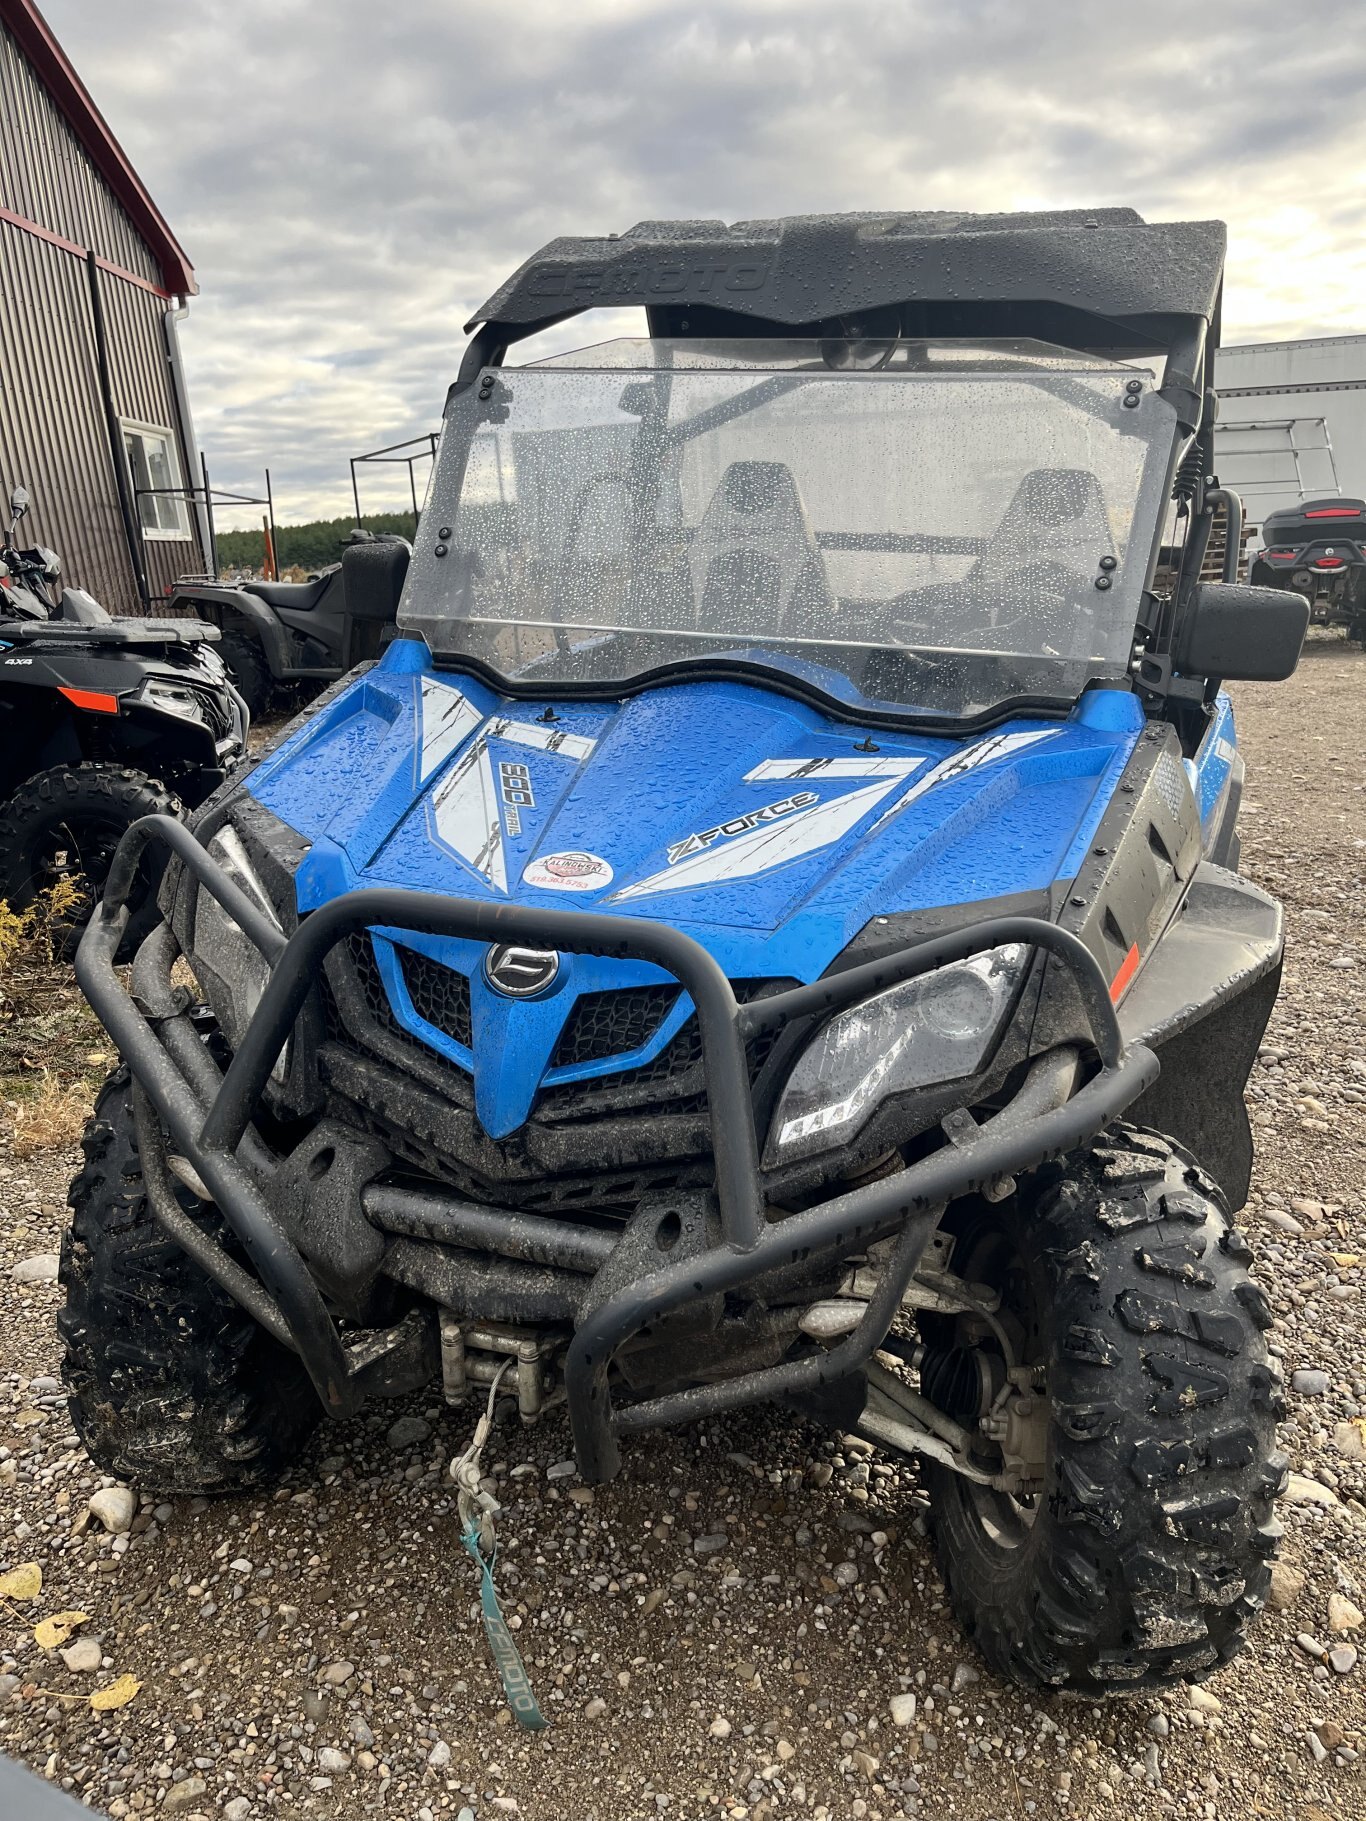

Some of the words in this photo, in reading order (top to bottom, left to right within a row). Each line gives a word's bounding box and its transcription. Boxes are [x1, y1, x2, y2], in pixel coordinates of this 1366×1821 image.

[527, 263, 769, 297] CFMOTO
[499, 762, 533, 807] 800
[504, 805, 521, 837] TRAIL
[543, 859, 604, 874] KALINOWSKI
[486, 1616, 534, 1711] CFMOTO
